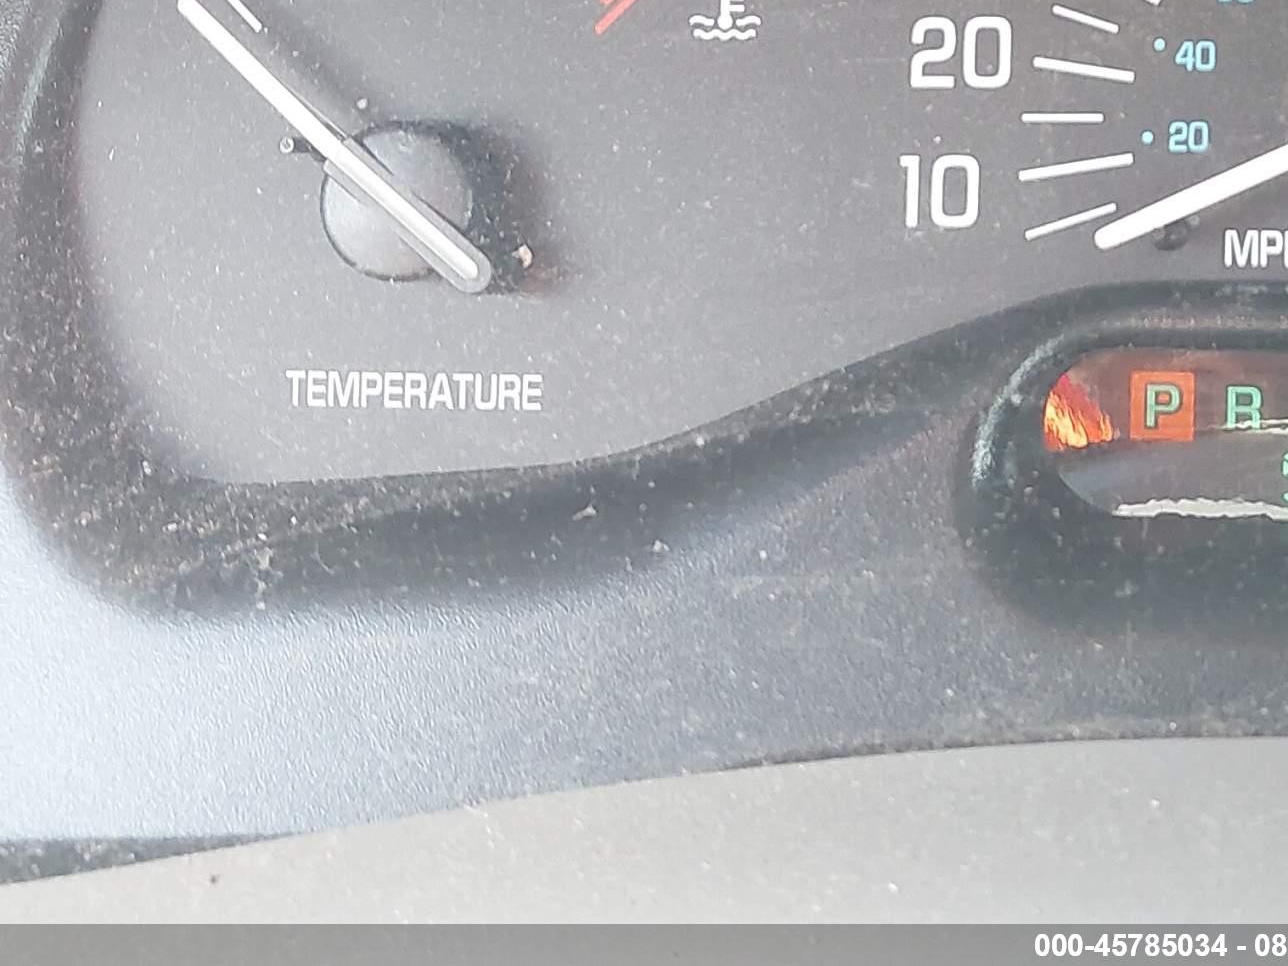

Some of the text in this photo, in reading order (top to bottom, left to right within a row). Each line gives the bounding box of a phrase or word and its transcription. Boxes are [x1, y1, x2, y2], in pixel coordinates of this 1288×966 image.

[911, 17, 1011, 88] 20
[1176, 41, 1215, 71] 40
[1169, 122, 1208, 152] 20
[900, 154, 980, 229] 10
[286, 370, 542, 410] TEMPERATURE
[1144, 383, 1182, 428] P
[1225, 385, 1261, 430] R
